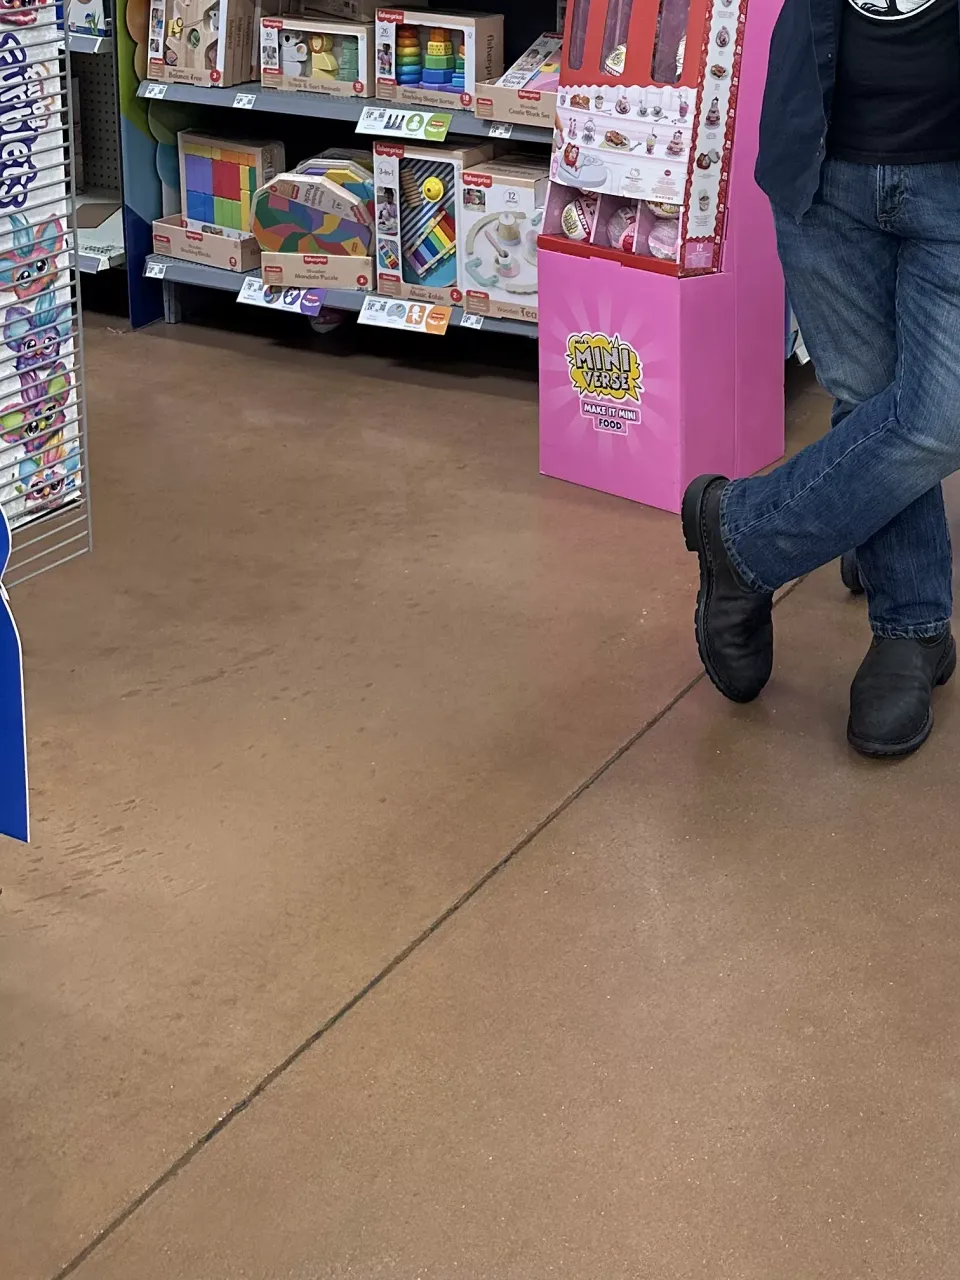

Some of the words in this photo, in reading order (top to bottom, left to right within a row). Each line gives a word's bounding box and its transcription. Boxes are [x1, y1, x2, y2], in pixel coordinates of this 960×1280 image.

[377, 12, 402, 21] fisher-price
[376, 145, 404, 155] fisher-price
[463, 174, 492, 185] fisher-price
[508, 191, 516, 199] 12
[410, 289, 428, 298] Music
[520, 307, 537, 319] Tea
[574, 346, 631, 372] MINI
[582, 370, 630, 391] VERSE
[584, 404, 606, 415] MAKE
[608, 407, 616, 417] IT
[618, 409, 637, 420] MINI
[599, 418, 622, 430] FOOD
